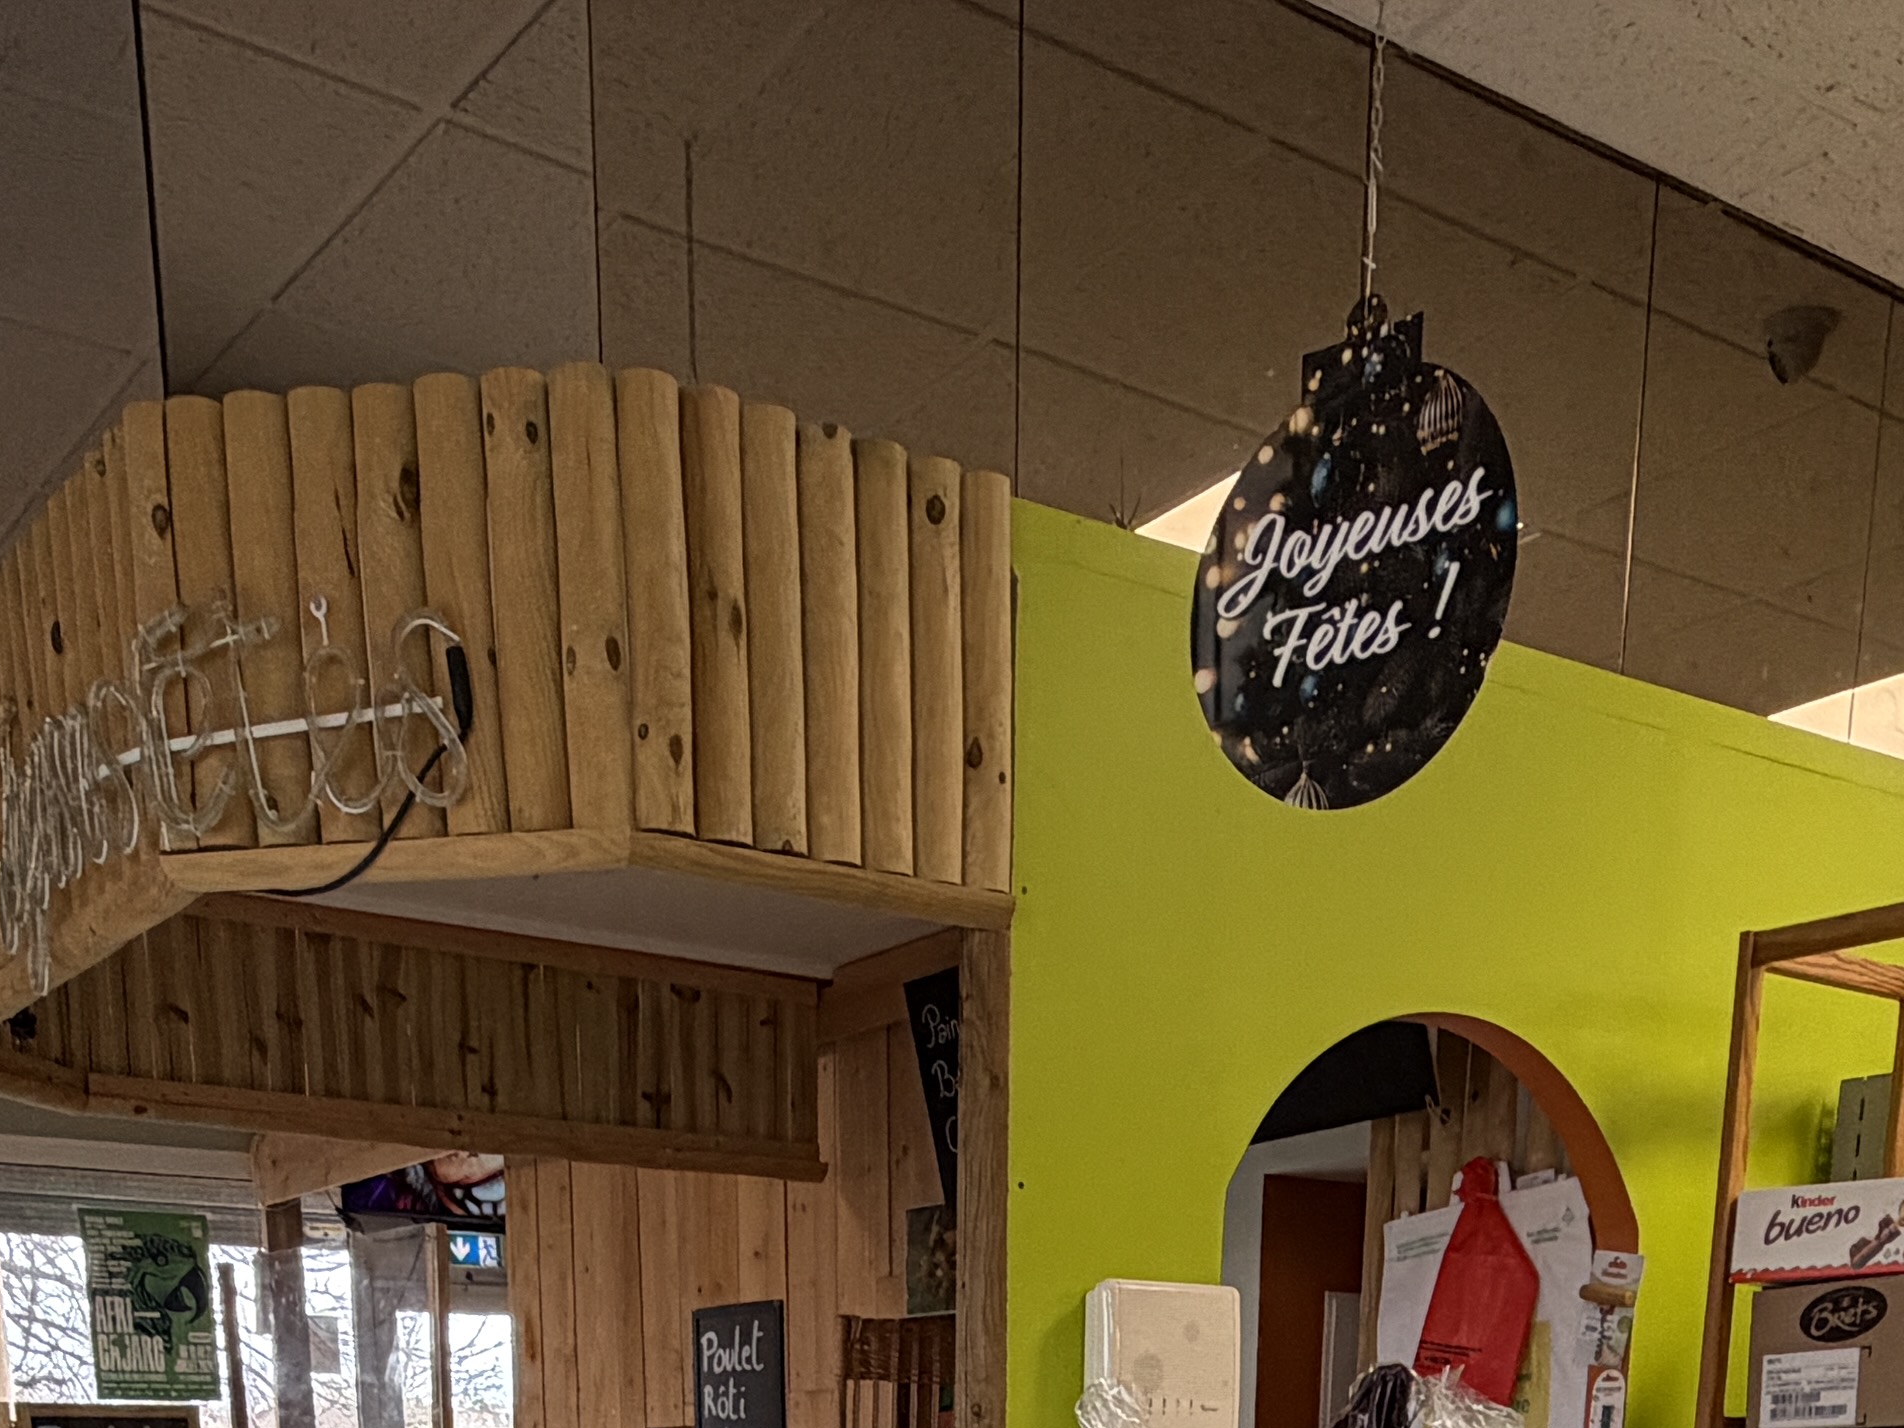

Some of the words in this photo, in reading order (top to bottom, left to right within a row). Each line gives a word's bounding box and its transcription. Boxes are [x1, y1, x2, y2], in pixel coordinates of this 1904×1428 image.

[1217, 466, 1491, 621] Joyeuses
[1263, 595, 1402, 688] Fêtes
[1426, 562, 1460, 638] !
[1763, 1204, 1861, 1246] bueno
[701, 1320, 764, 1374] Poulet
[703, 1377, 746, 1420] Rôti
